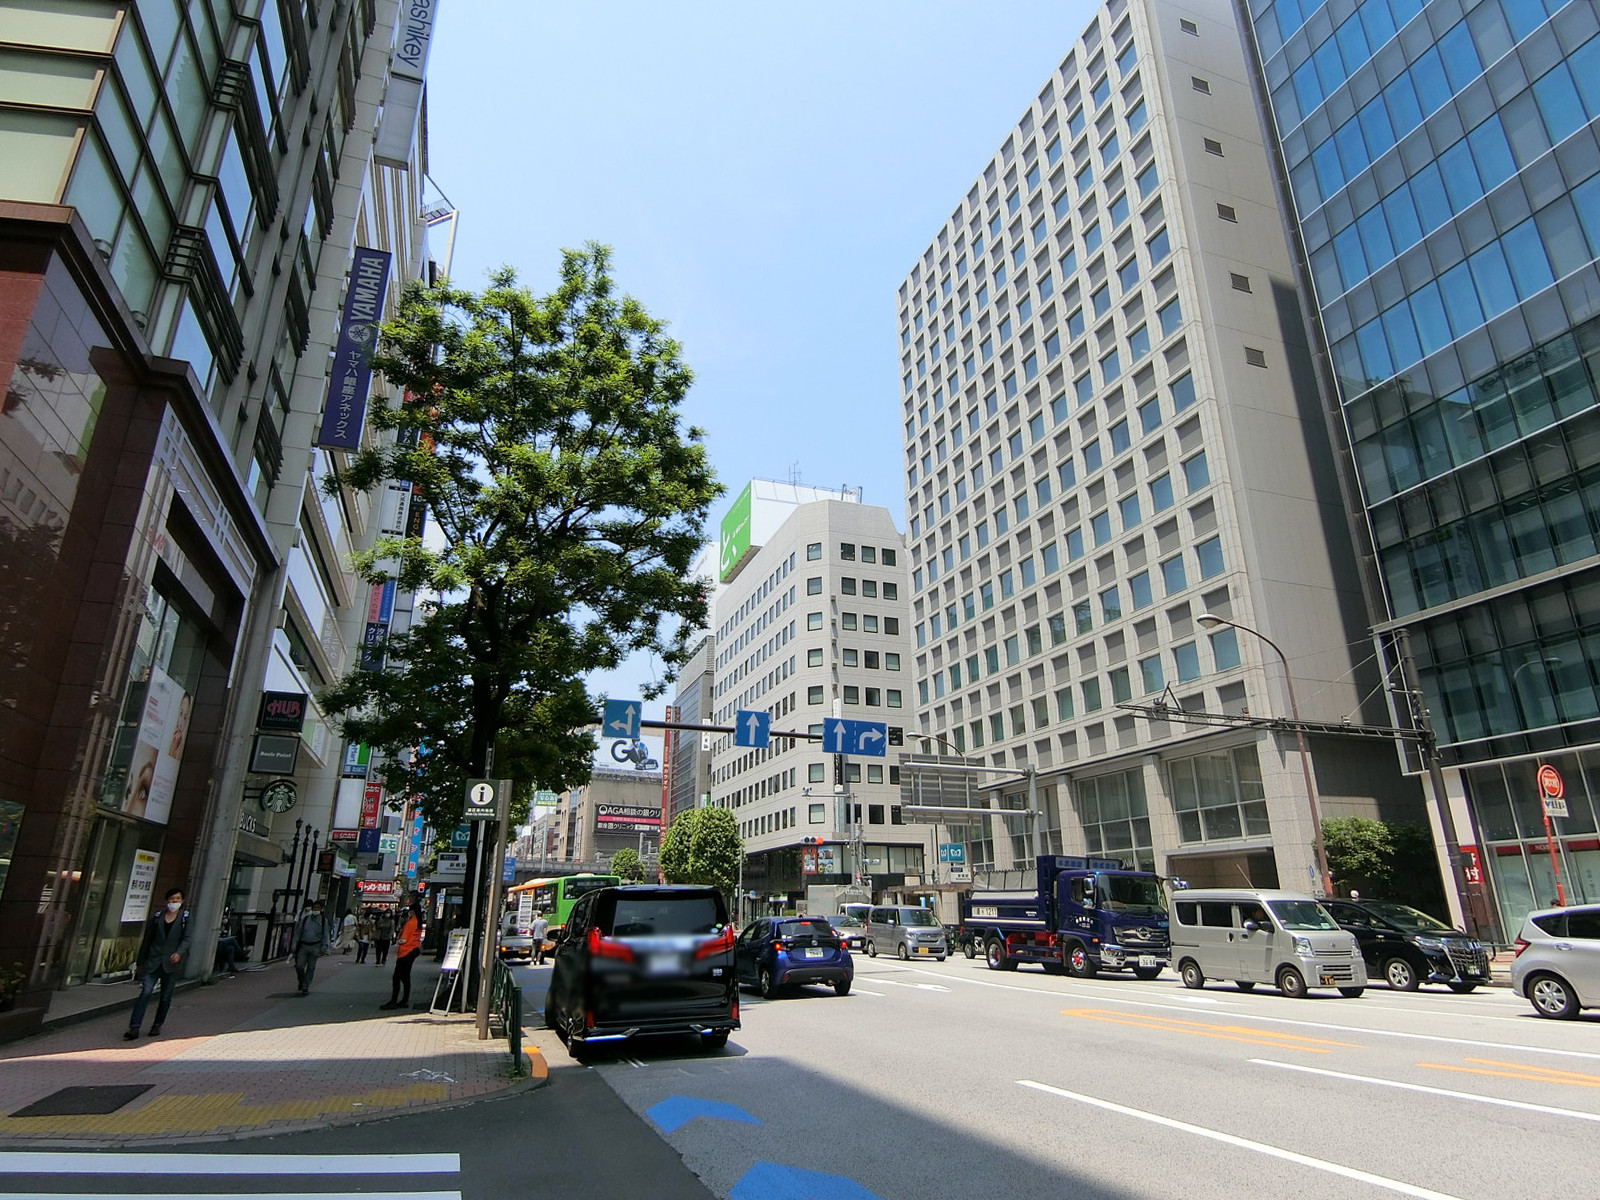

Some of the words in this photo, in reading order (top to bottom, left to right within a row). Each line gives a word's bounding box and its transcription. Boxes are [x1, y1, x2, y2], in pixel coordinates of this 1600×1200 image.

[350, 257, 384, 321] YAMAHA
[334, 350, 362, 439] ヤマハ銀座アネックス
[266, 699, 301, 718] HUB
[380, 838, 397, 849] 宝石
